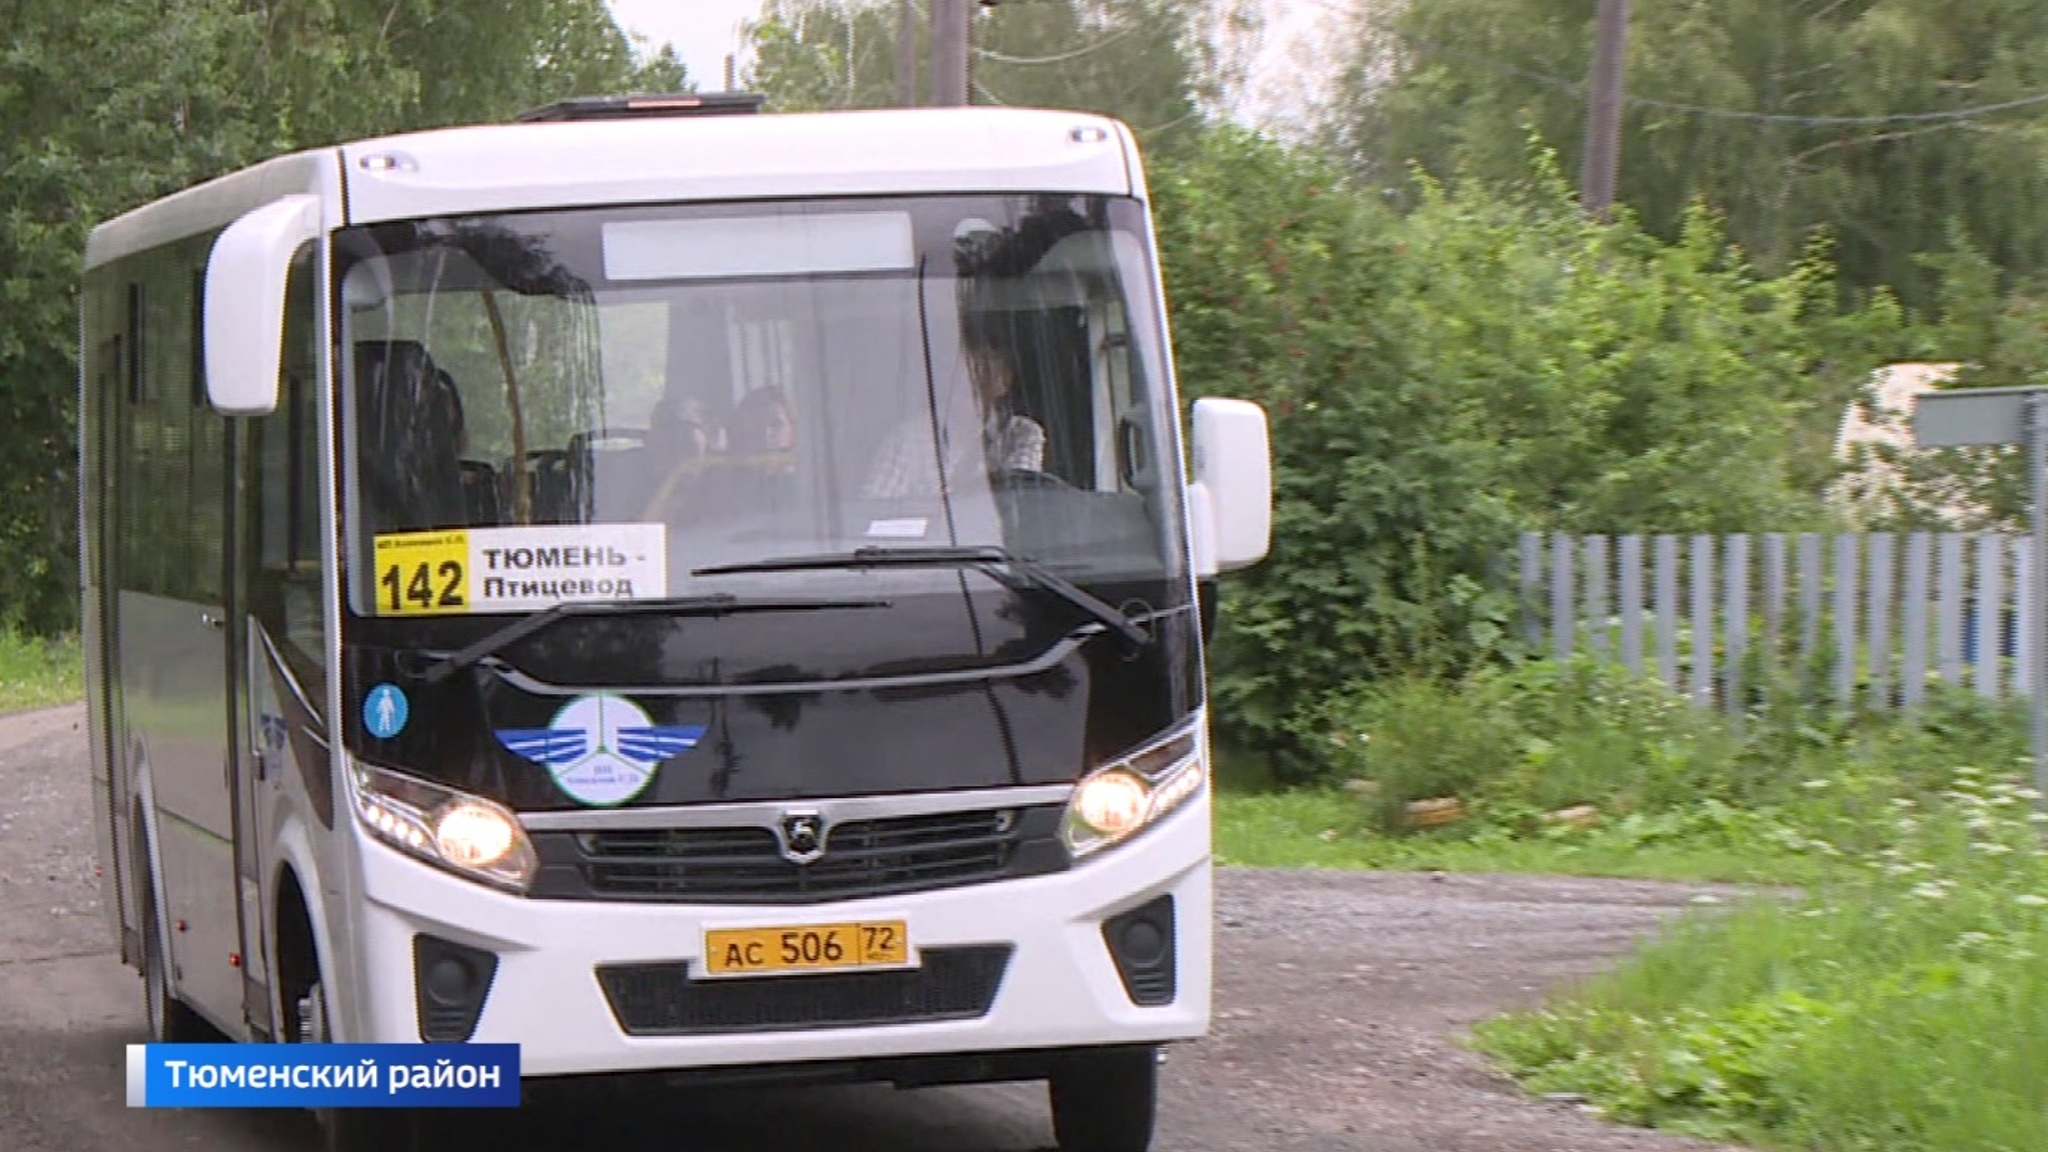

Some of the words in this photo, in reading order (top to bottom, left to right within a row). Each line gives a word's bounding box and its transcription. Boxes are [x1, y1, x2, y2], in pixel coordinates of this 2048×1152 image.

[483, 547, 626, 570] ТЮМЕНЬ
[380, 560, 464, 610] 142
[483, 575, 634, 598] Птицевод
[781, 931, 844, 964] 506
[862, 927, 895, 950] 72
